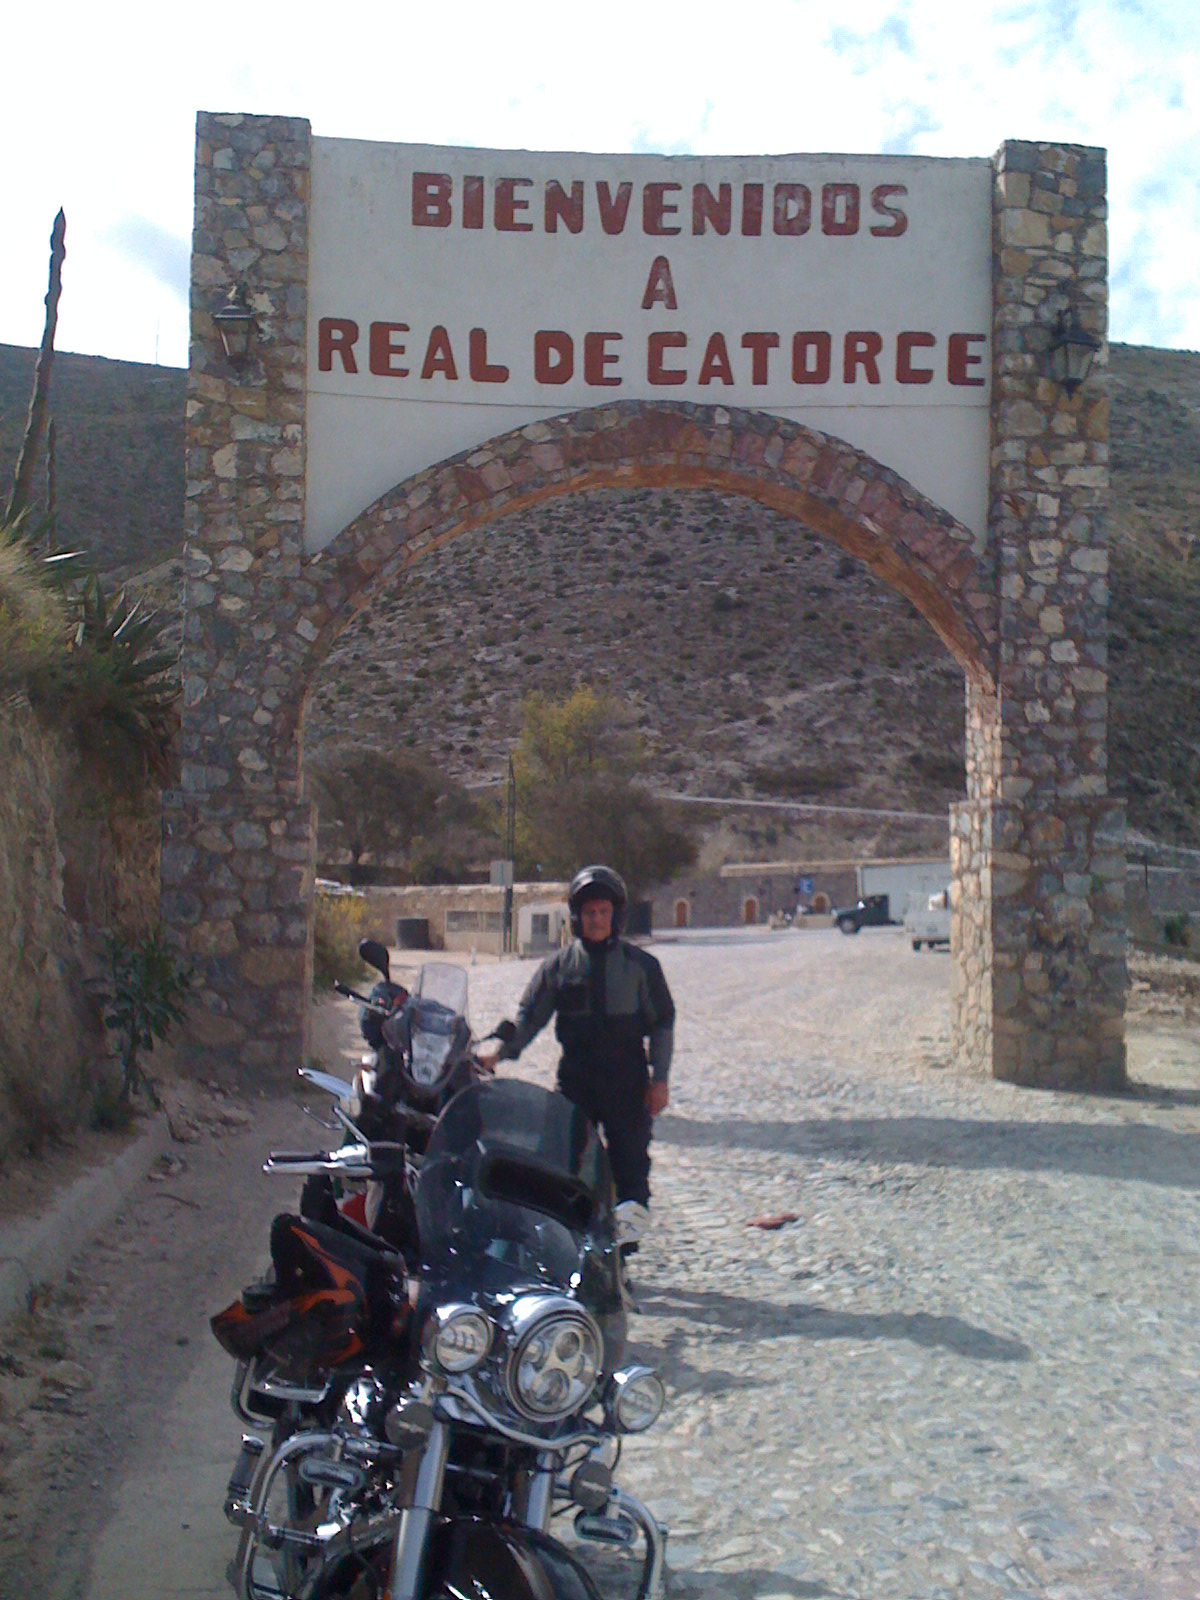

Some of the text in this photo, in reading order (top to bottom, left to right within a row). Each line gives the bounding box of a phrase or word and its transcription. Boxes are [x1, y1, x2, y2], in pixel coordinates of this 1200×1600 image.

[411, 171, 910, 238] BIENVENIDOS
[640, 255, 679, 311] A
[317, 317, 989, 387] REAL DE CATORCE
